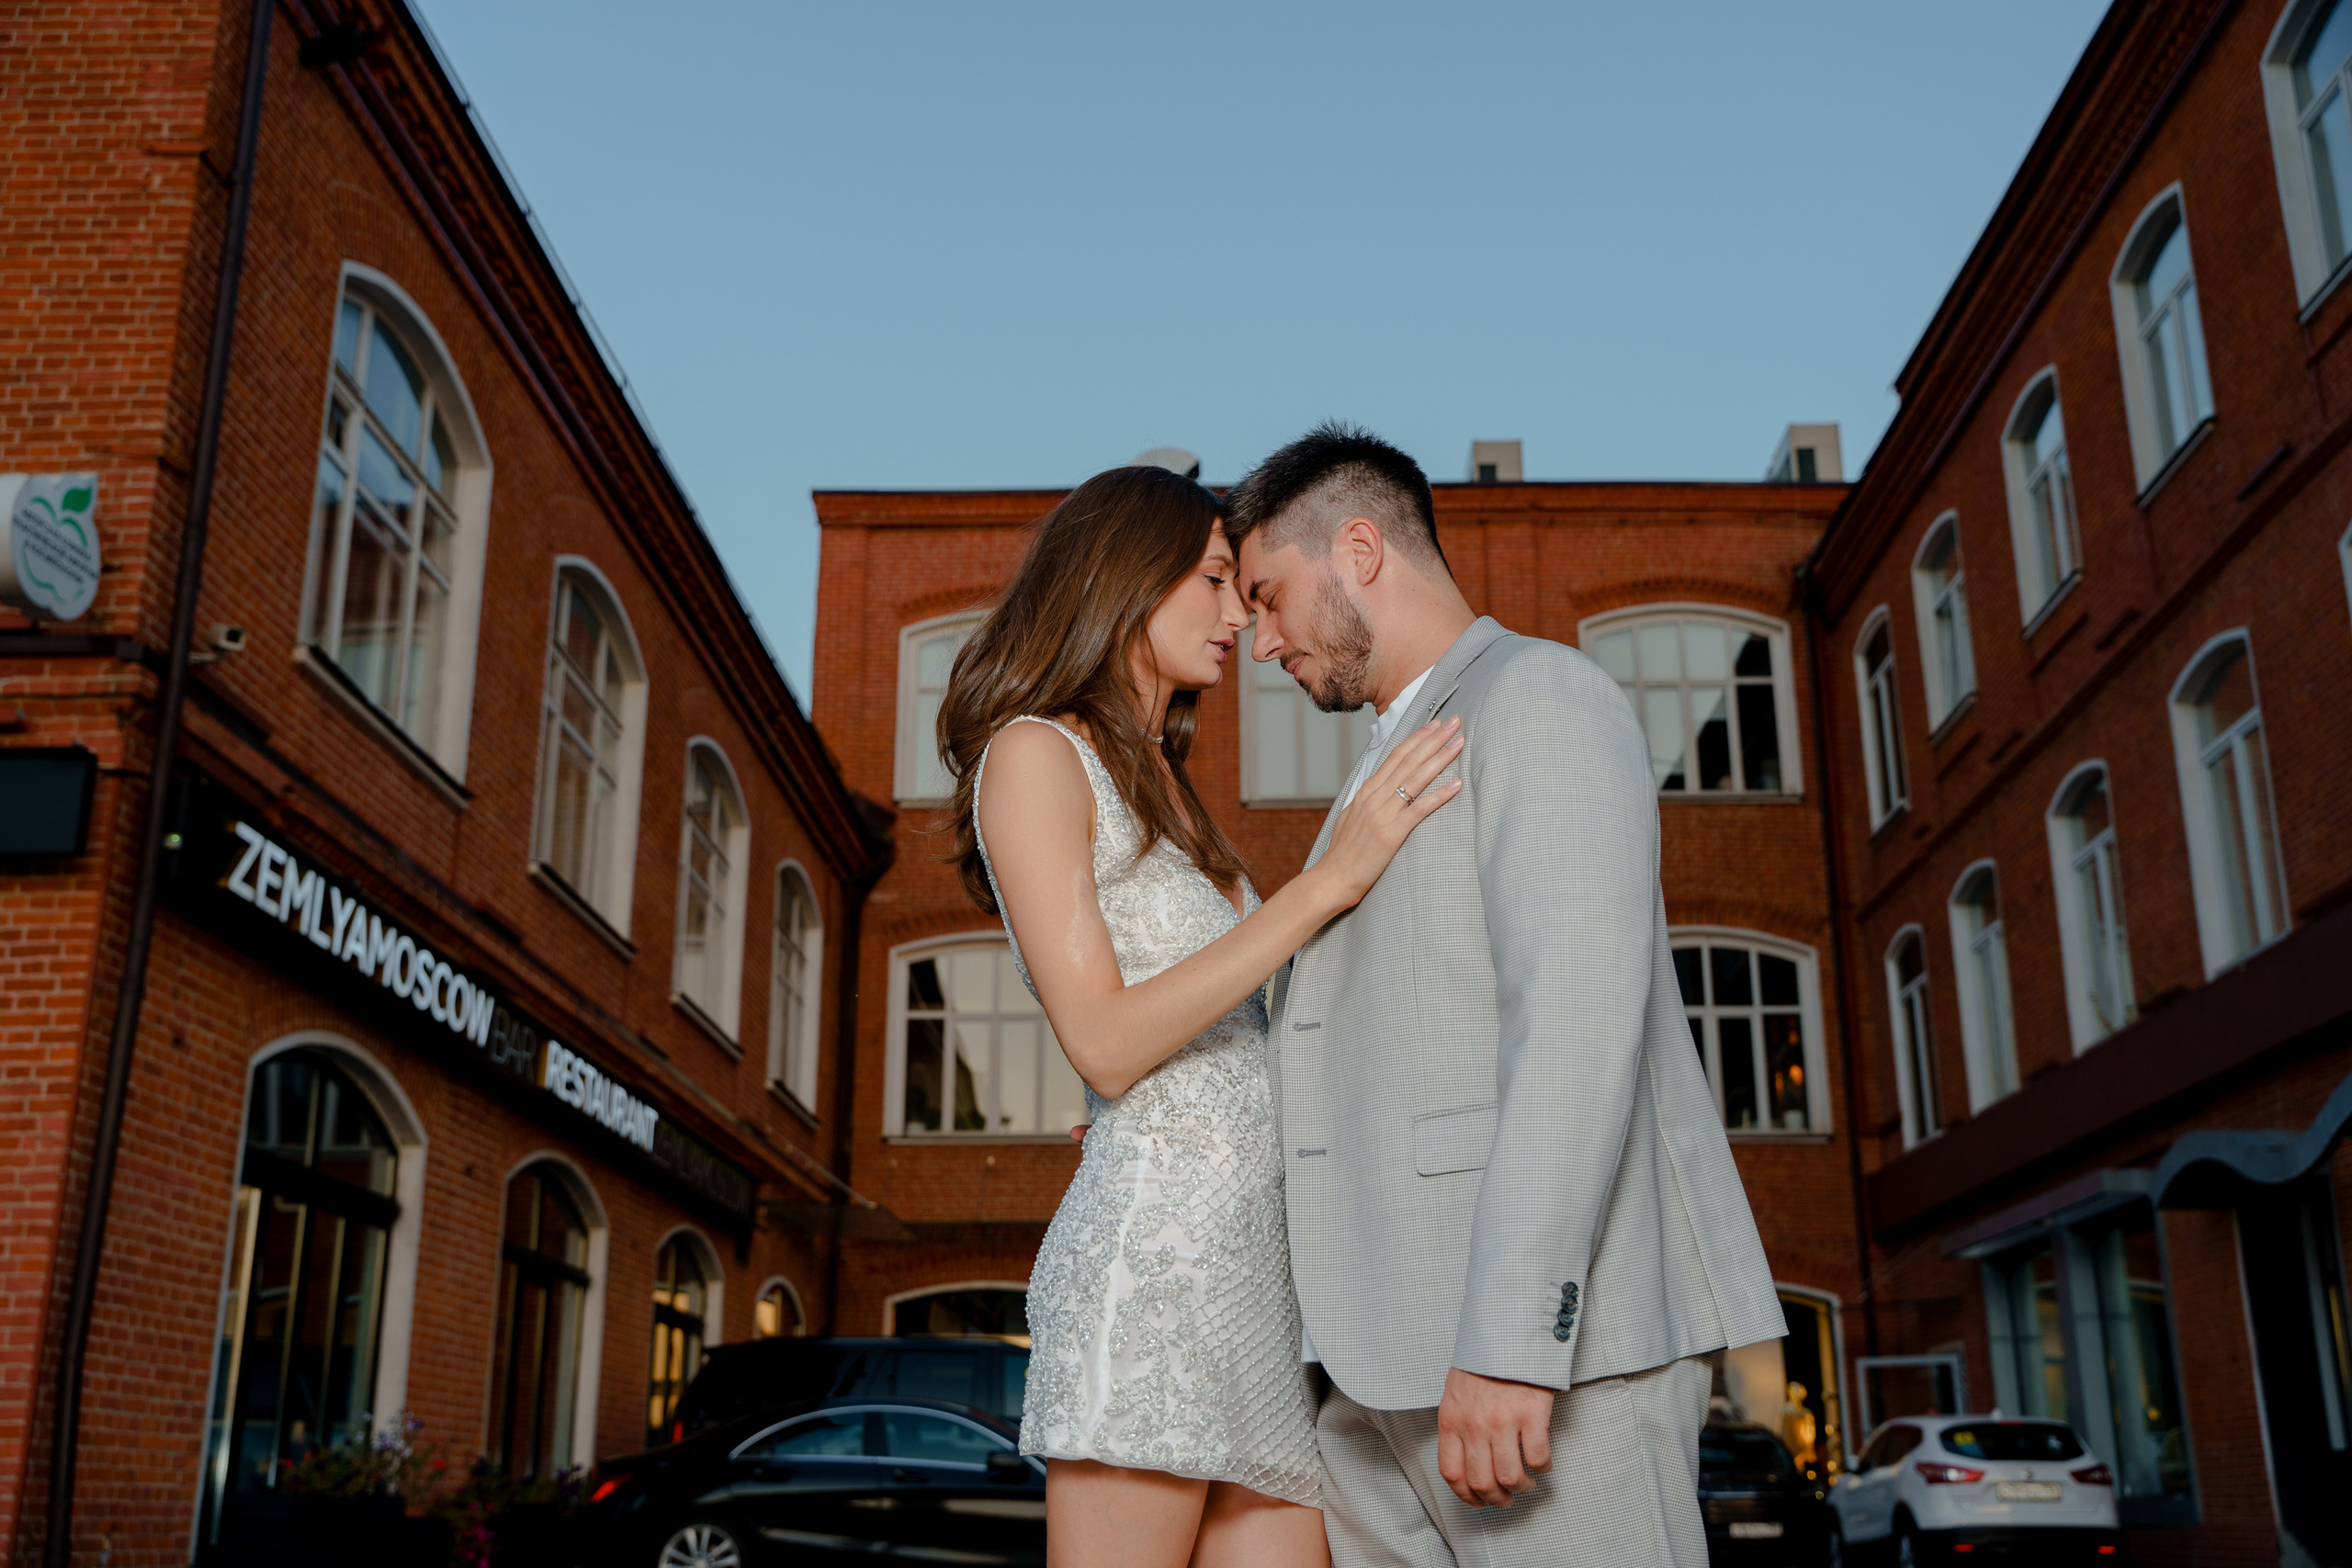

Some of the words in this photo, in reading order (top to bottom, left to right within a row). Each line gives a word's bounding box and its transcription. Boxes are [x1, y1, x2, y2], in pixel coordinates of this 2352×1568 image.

[228, 819, 495, 1048] ZEMLYAMOSCOW
[489, 1006, 537, 1083] BAR
[544, 1039, 659, 1153] RESTAURANT
